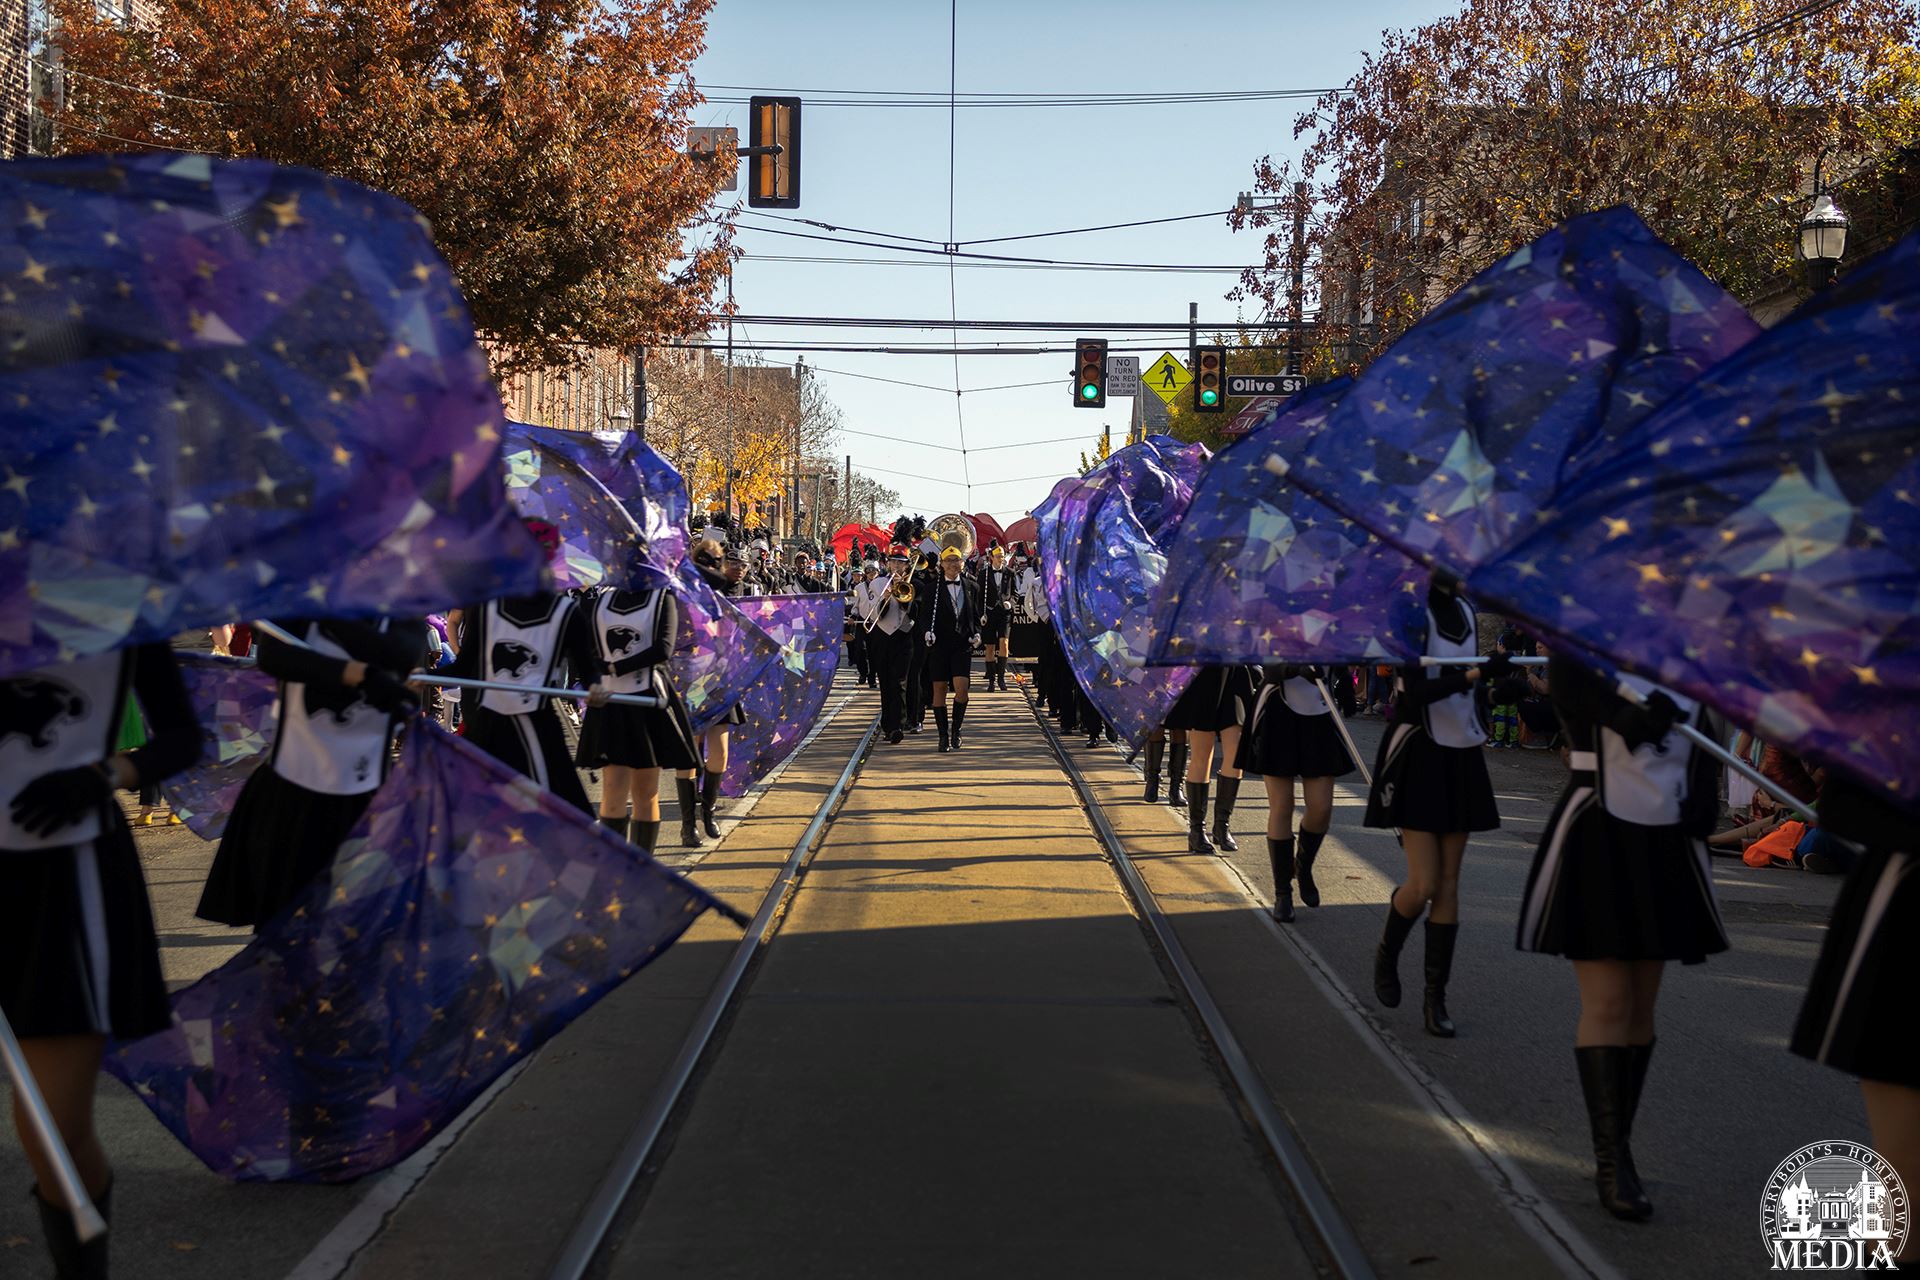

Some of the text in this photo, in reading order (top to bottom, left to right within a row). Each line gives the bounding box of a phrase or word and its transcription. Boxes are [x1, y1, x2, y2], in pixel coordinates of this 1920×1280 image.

[1116, 358, 1130, 366] NO
[1232, 378, 1302, 392] Olive St
